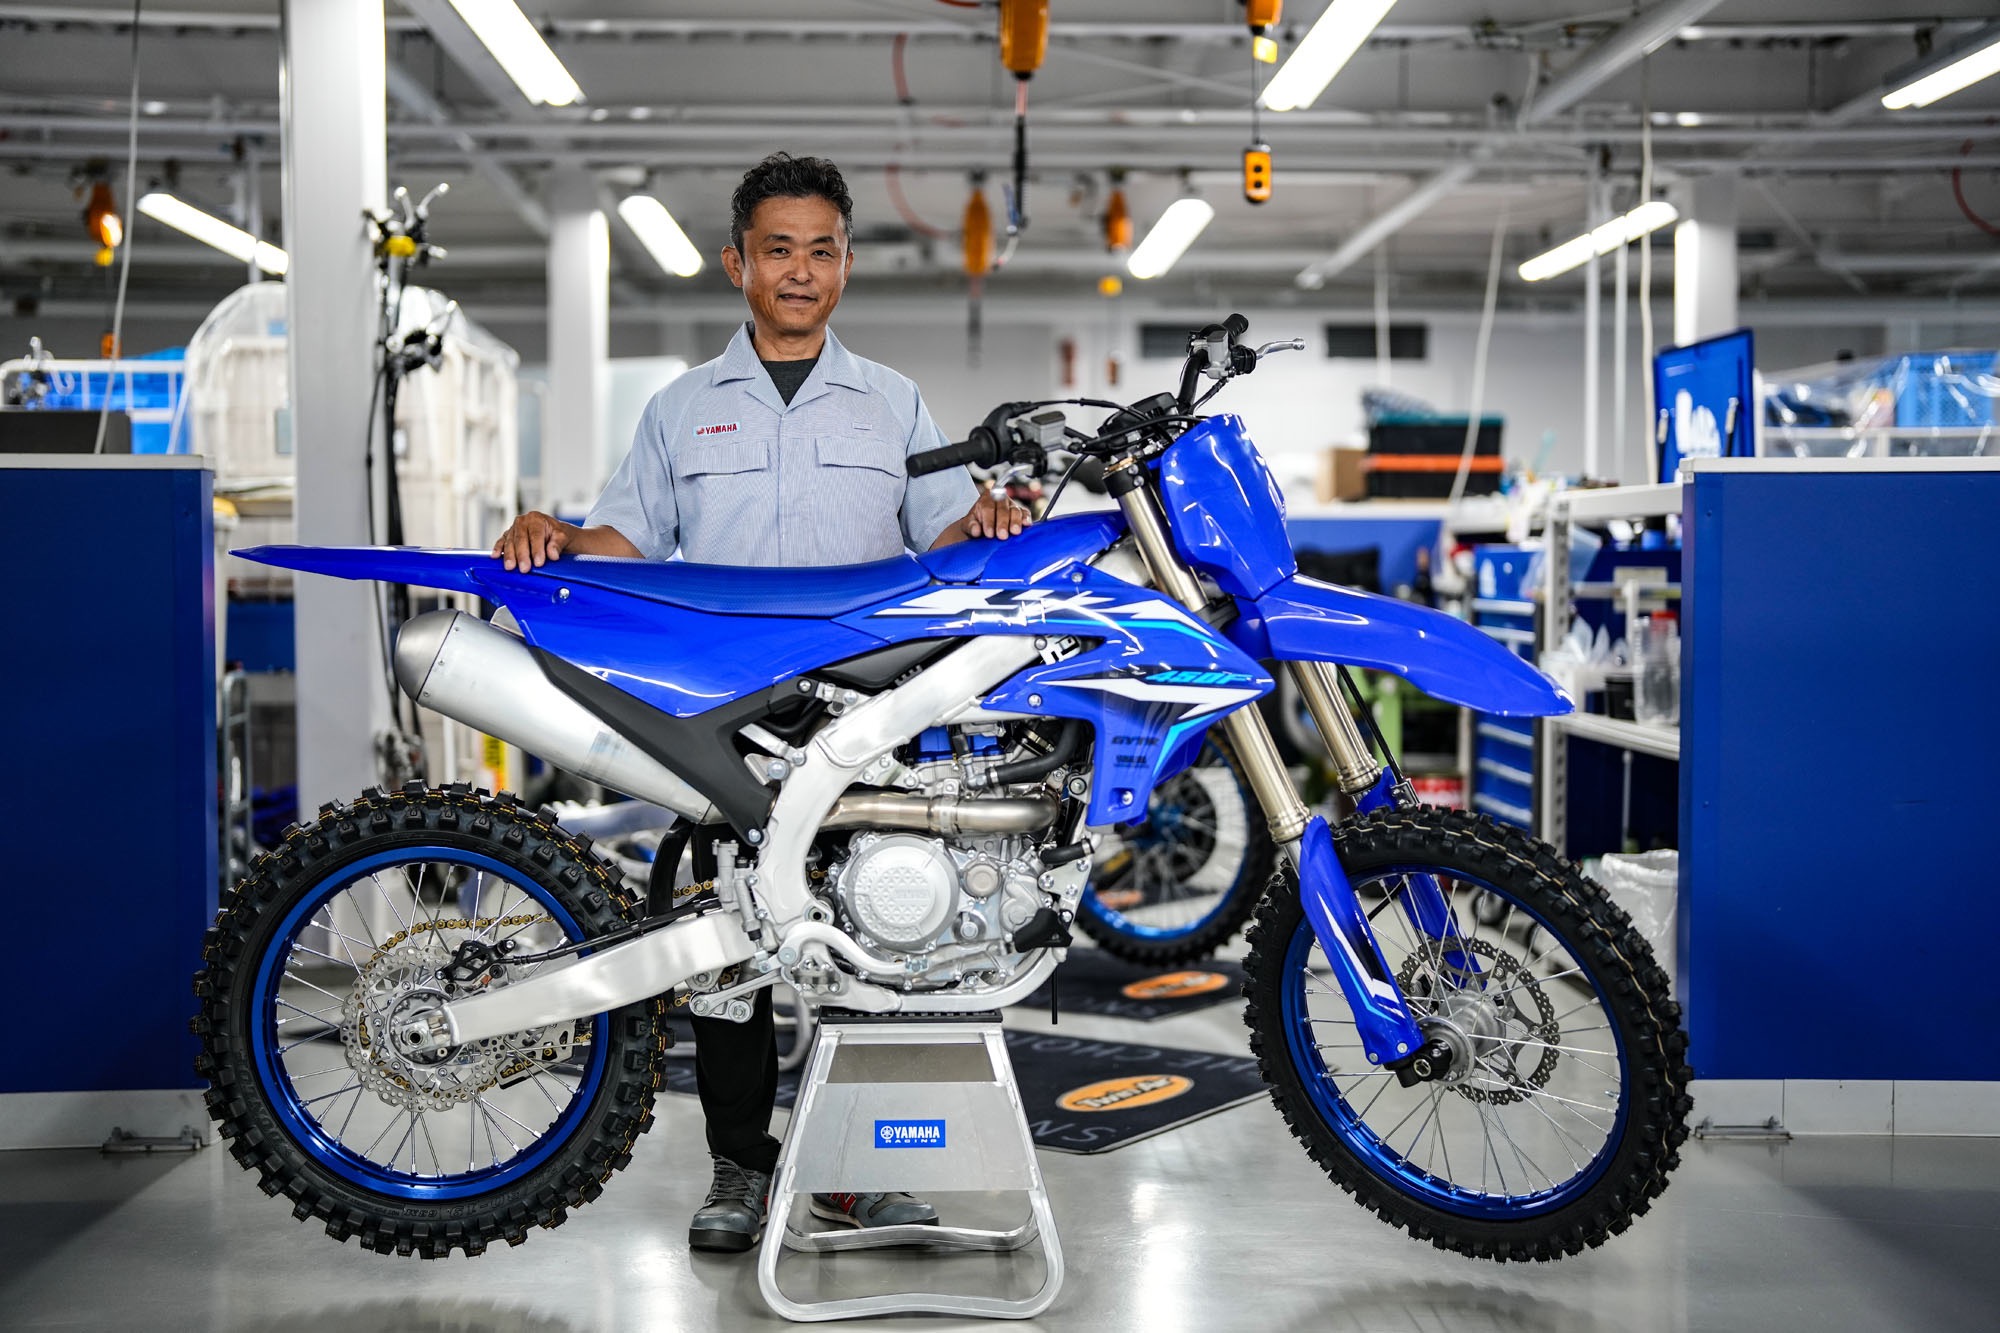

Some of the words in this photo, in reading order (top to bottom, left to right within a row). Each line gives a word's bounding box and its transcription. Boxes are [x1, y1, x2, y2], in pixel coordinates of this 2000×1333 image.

[705, 423, 737, 434] YAMAHA
[1072, 1088, 1141, 1108] Twin
[894, 1126, 940, 1138] YAMAHA
